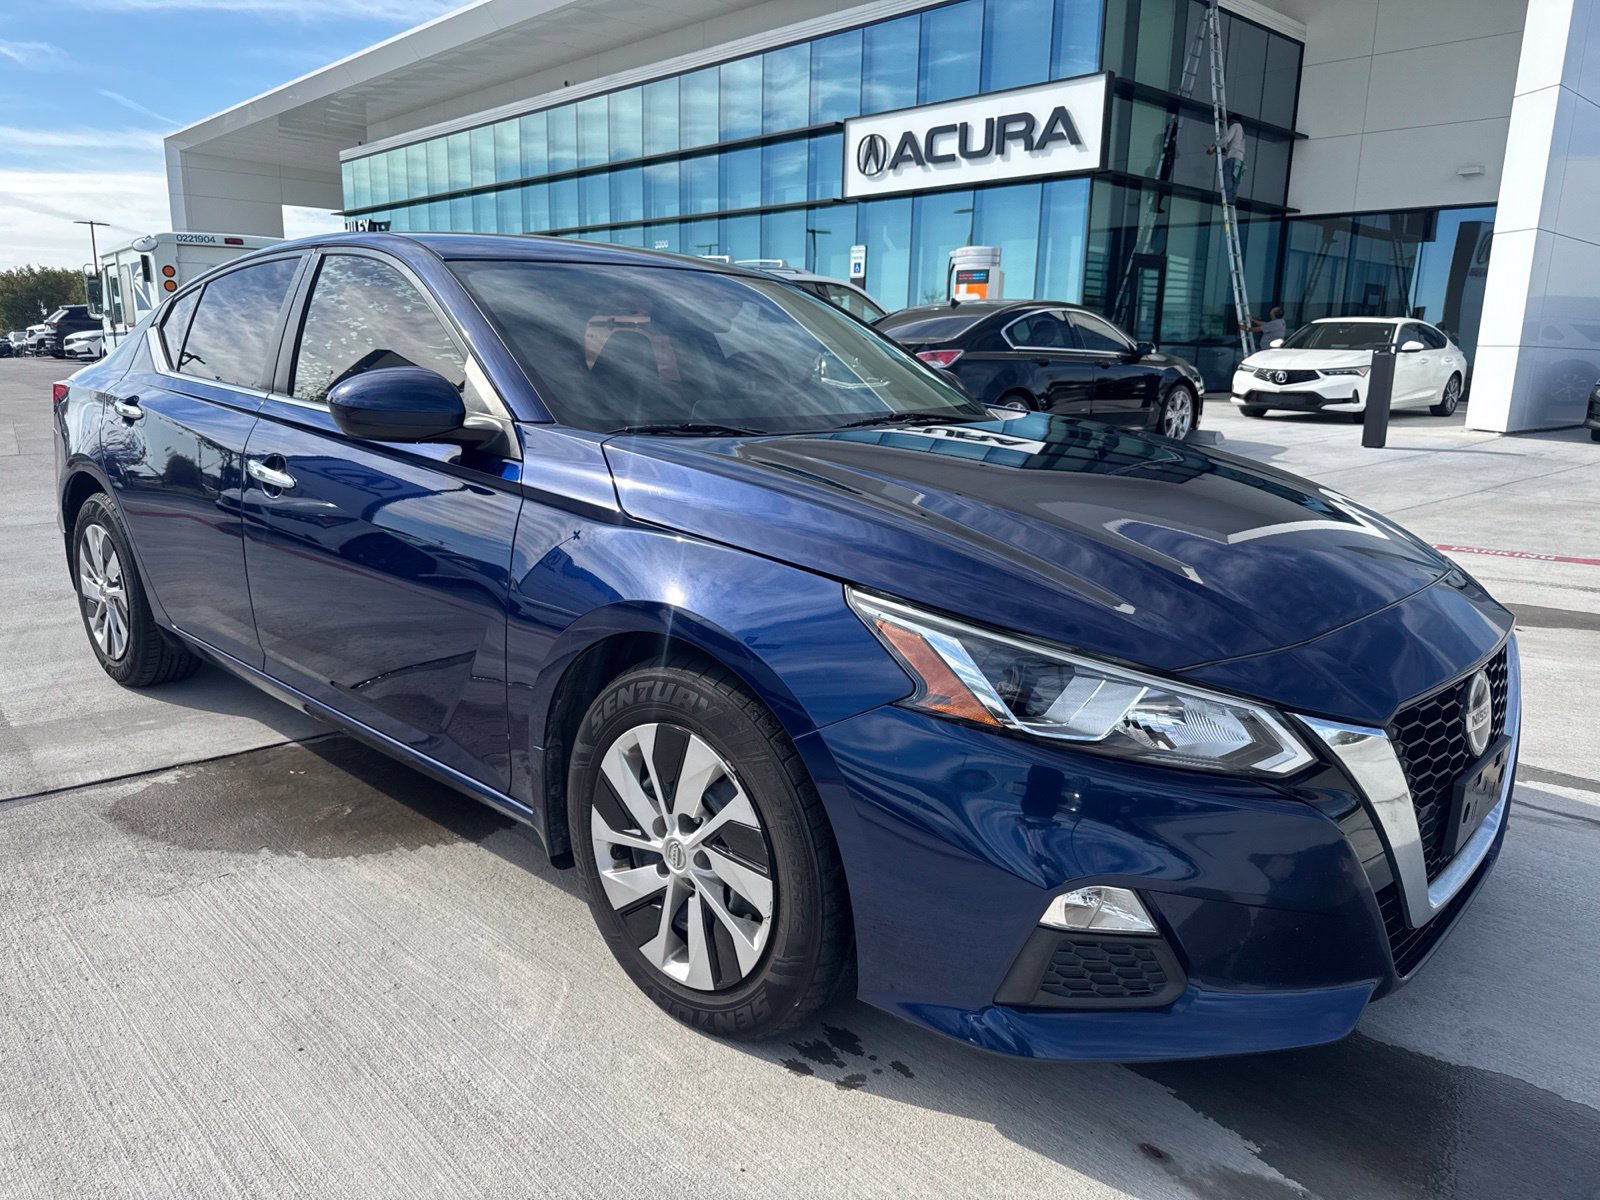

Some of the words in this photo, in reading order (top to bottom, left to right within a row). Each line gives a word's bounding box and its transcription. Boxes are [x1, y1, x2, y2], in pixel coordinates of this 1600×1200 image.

[888, 105, 1082, 170] ACURA
[175, 234, 217, 244] 0221904
[1450, 546, 1557, 561] PARKING
[590, 680, 724, 737] SENTURY
